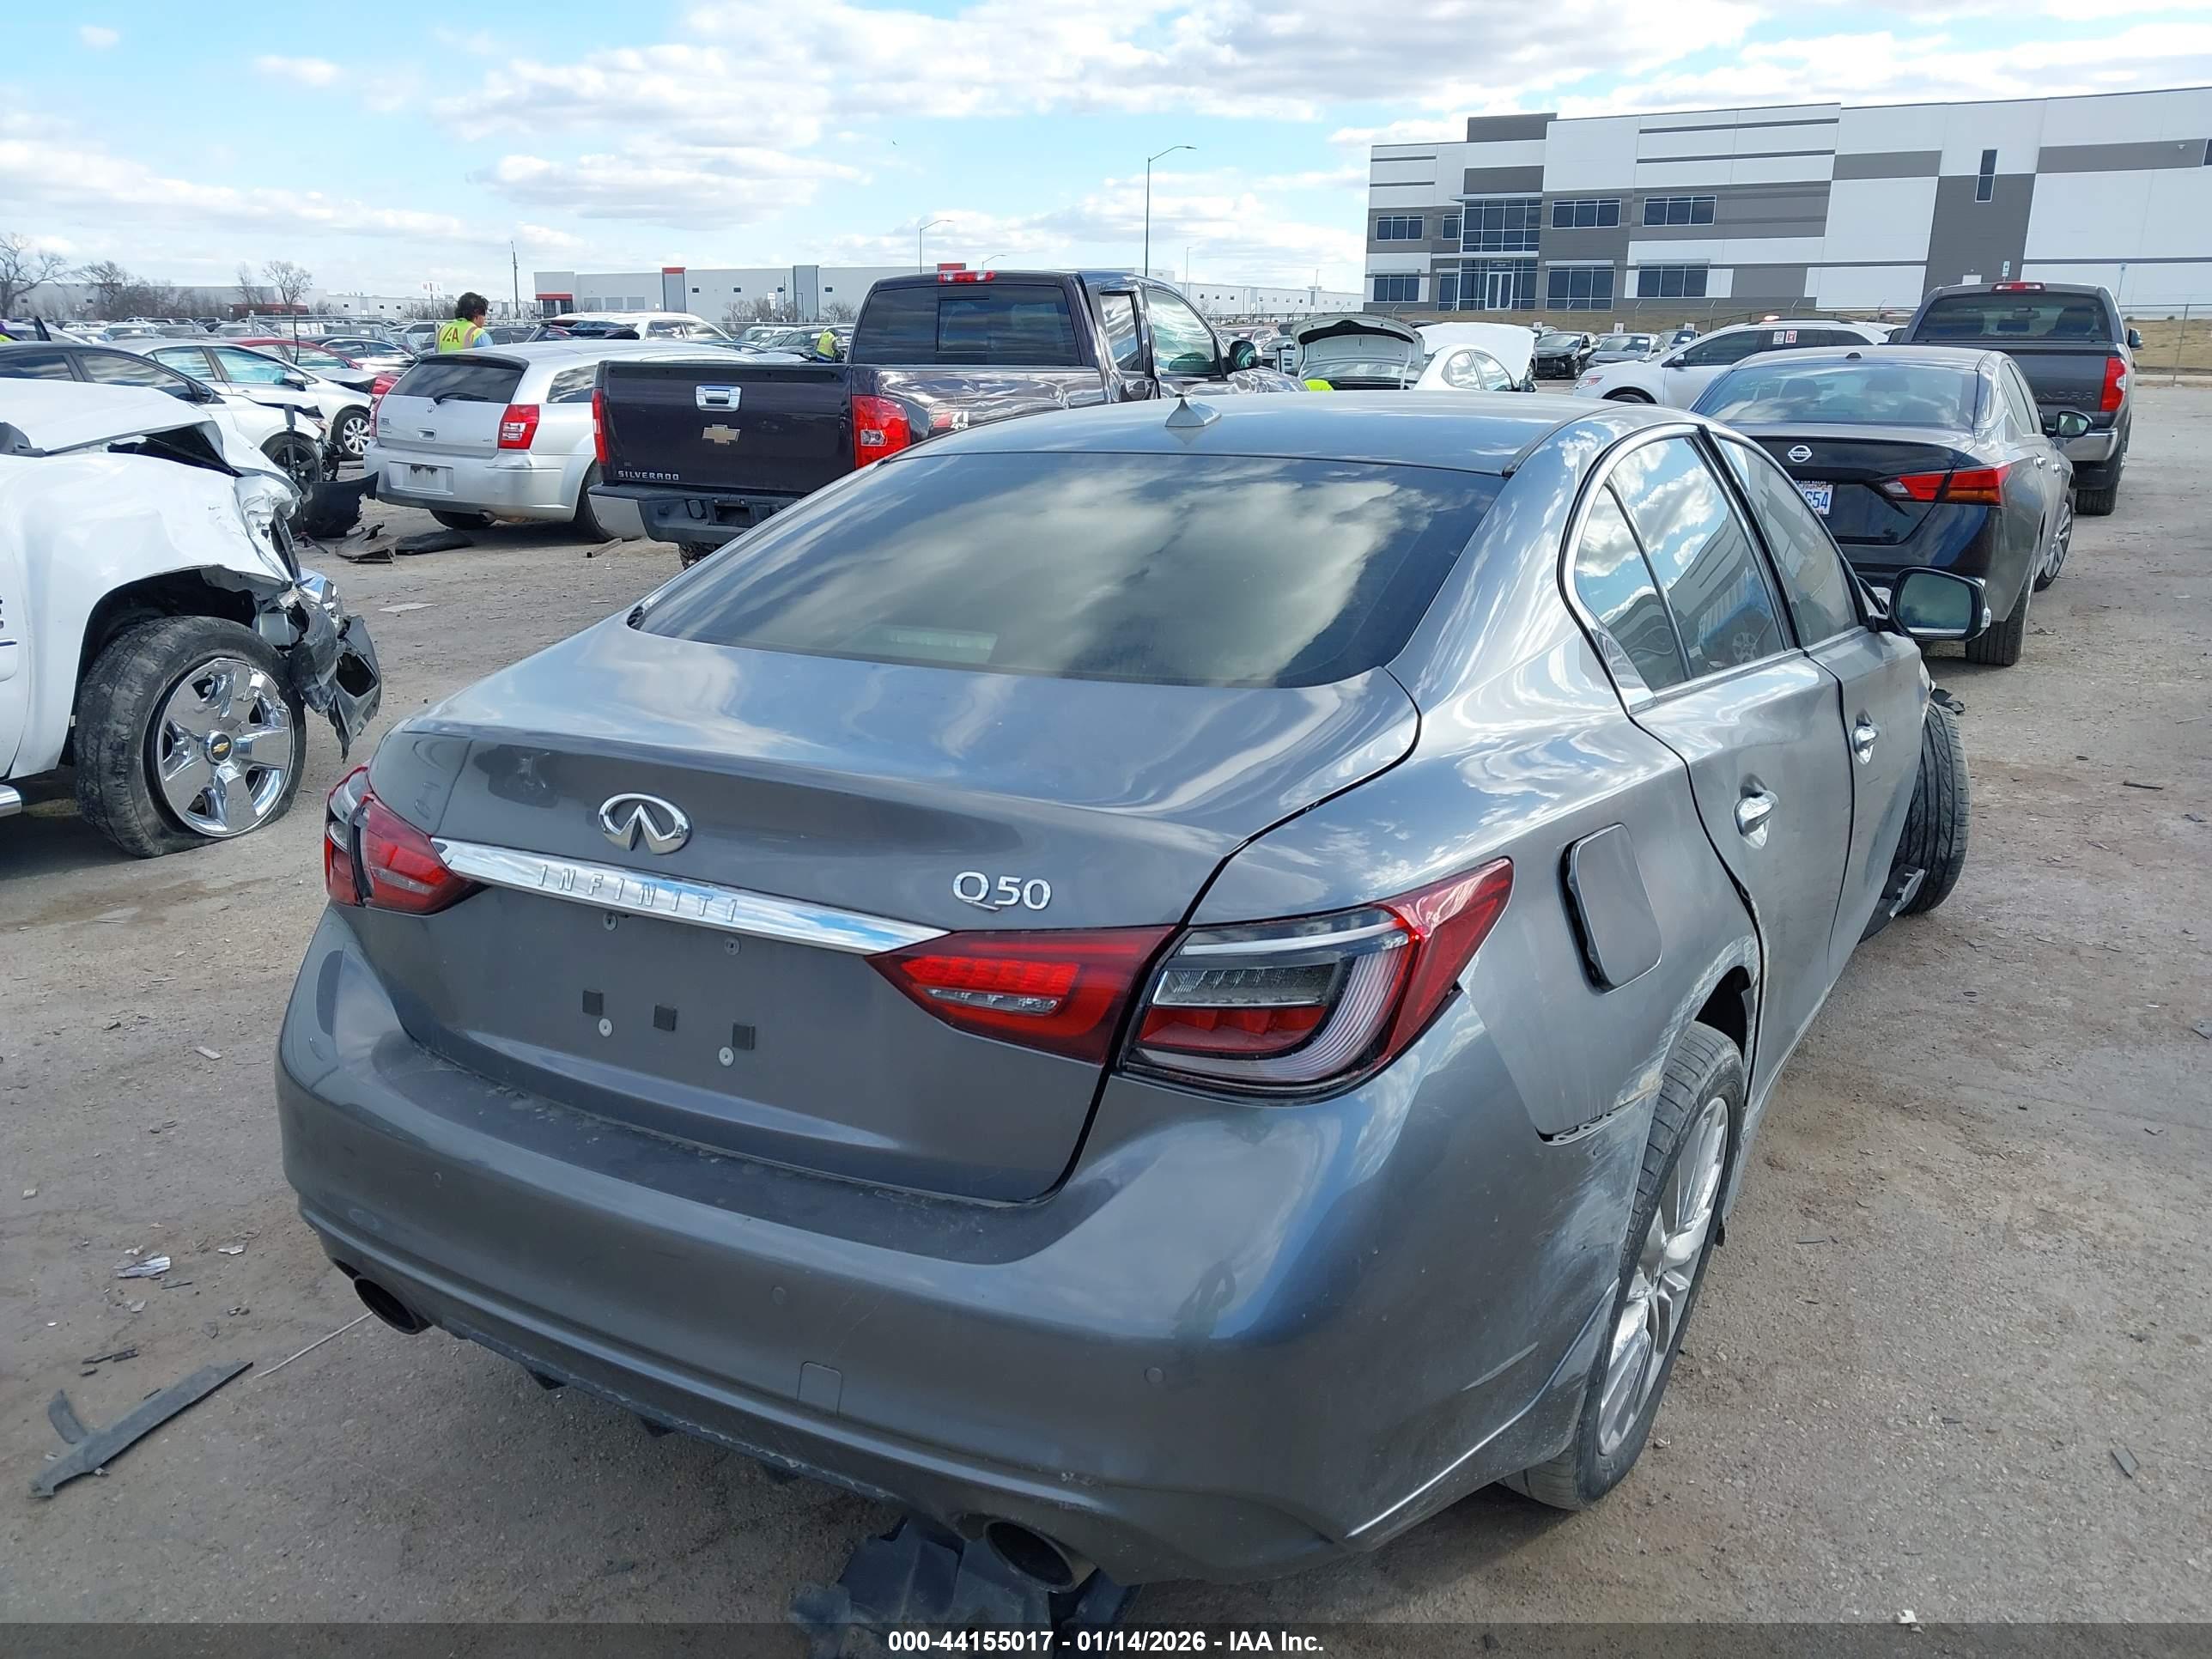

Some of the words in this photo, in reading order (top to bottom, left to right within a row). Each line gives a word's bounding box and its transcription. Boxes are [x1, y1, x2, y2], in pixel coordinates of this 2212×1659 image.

[617, 471, 679, 481] SILVERADO
[538, 864, 738, 922] INFINITI
[952, 871, 1052, 911] Q50
